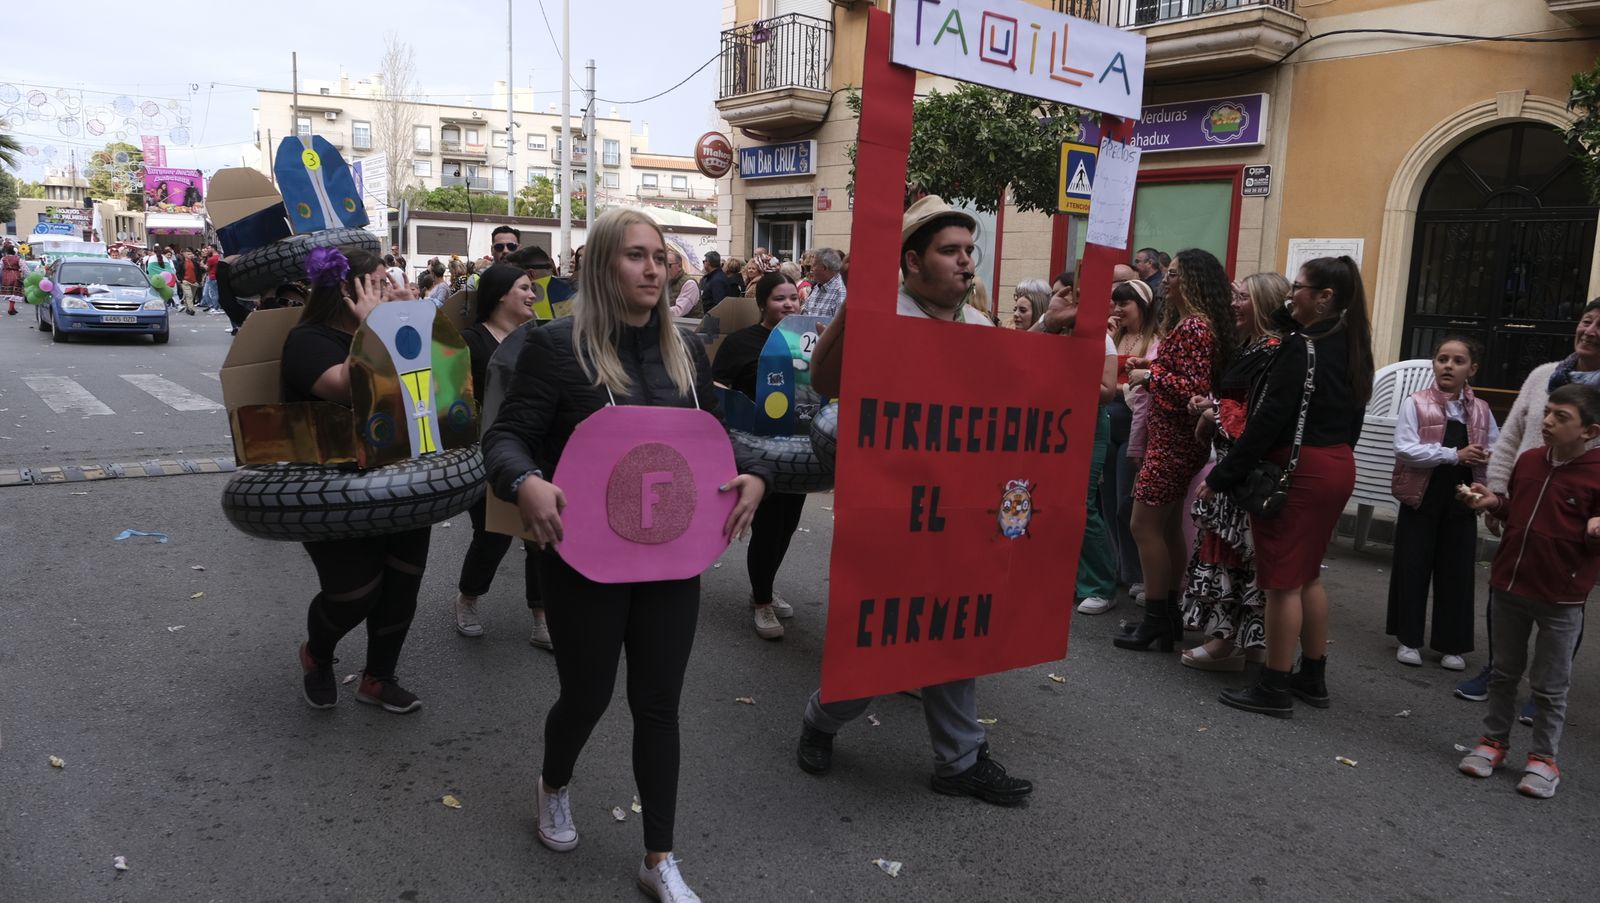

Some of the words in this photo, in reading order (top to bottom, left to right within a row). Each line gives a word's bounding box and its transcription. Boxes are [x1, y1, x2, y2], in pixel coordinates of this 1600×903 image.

[1140, 109, 1188, 125] Verduras
[1130, 130, 1170, 147] ahadux
[307, 152, 316, 167] 3
[774, 146, 796, 172] CRUZ
[1303, 366, 1315, 394] LLA
[640, 471, 673, 529] F
[909, 485, 946, 533] EL
[856, 593, 993, 648] CARMEN
